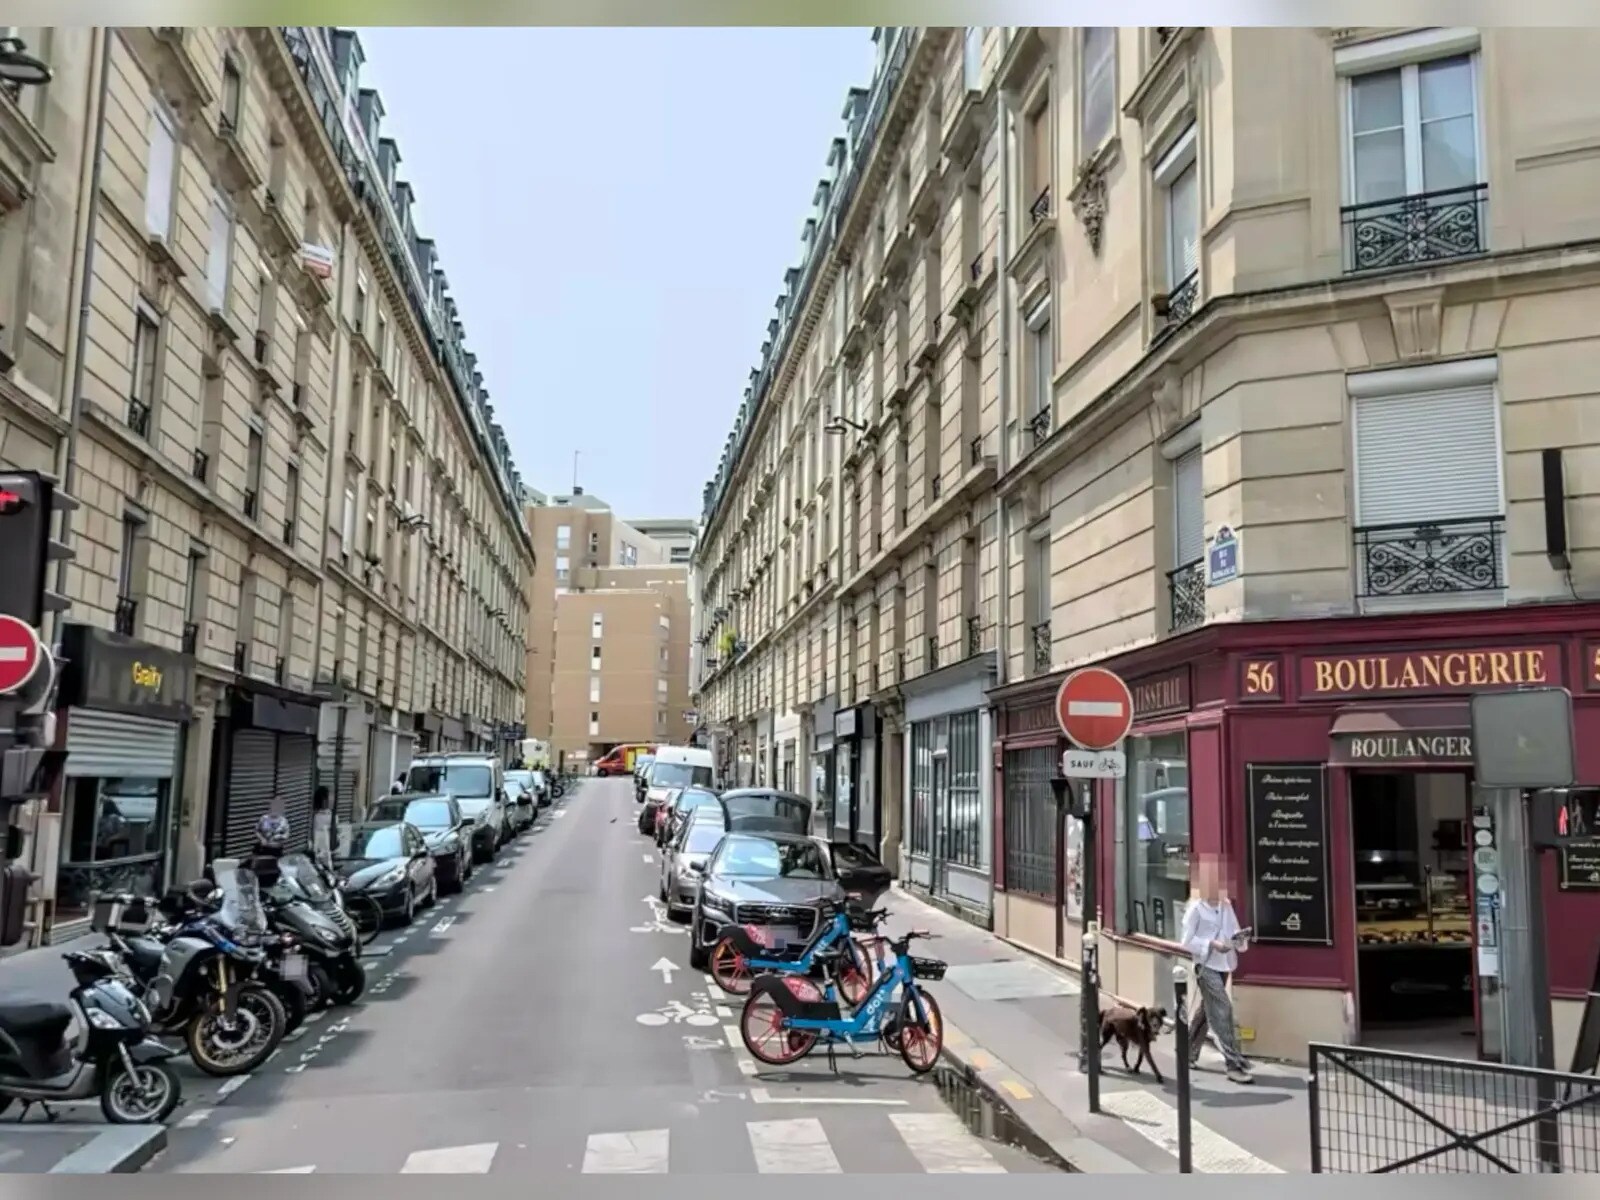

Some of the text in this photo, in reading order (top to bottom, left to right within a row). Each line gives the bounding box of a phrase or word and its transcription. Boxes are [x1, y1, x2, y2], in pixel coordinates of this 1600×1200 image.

[1247, 662, 1274, 693] 56
[1314, 650, 1547, 692] BOULANGERIE
[1351, 736, 1473, 758] BOULANGER
[1070, 759, 1095, 769] SAUF
